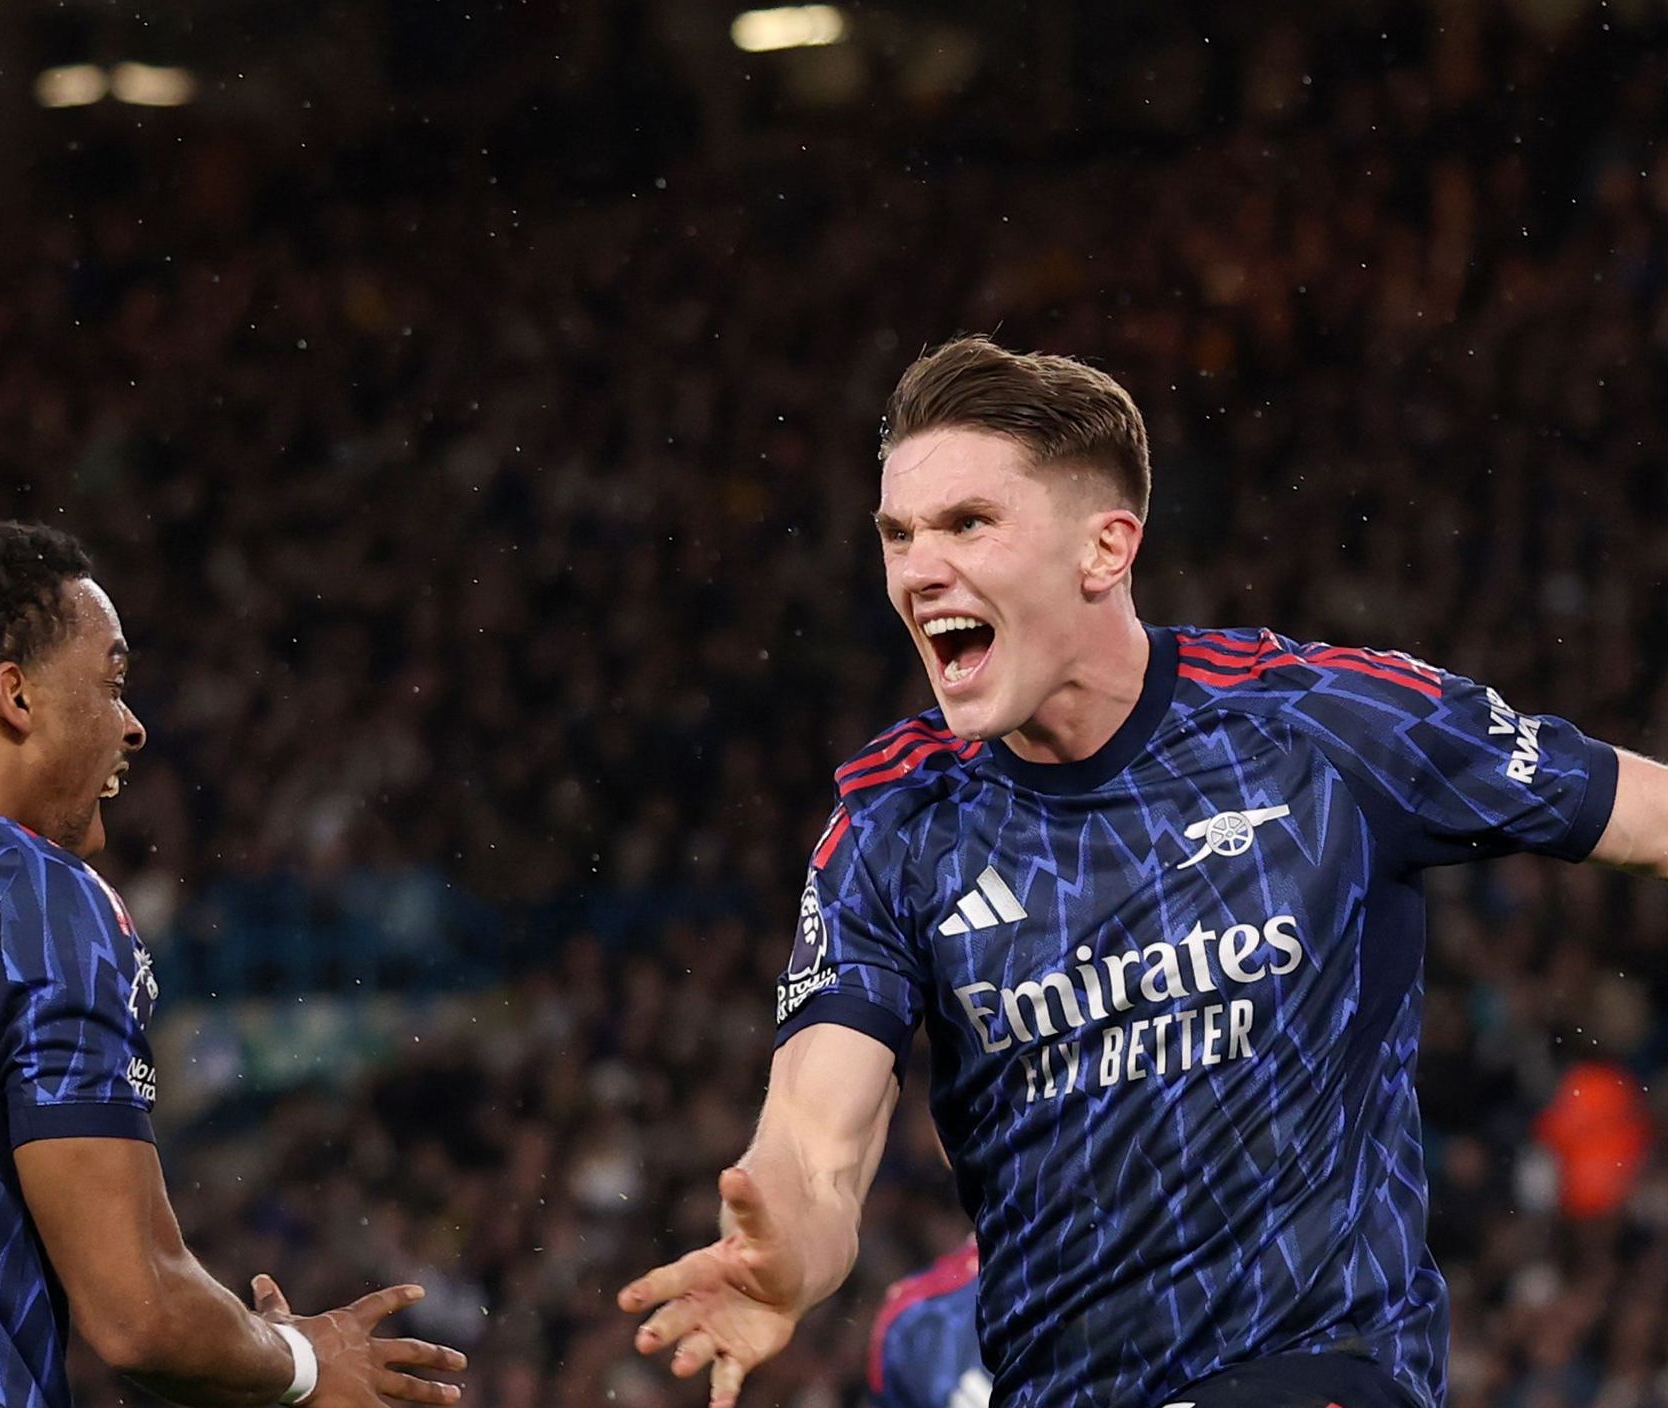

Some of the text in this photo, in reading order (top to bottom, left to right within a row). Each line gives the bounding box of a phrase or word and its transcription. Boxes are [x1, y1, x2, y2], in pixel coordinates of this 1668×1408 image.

[954, 915, 1303, 1054] Emirates
[1019, 999, 1254, 1103] FLY BETTER
